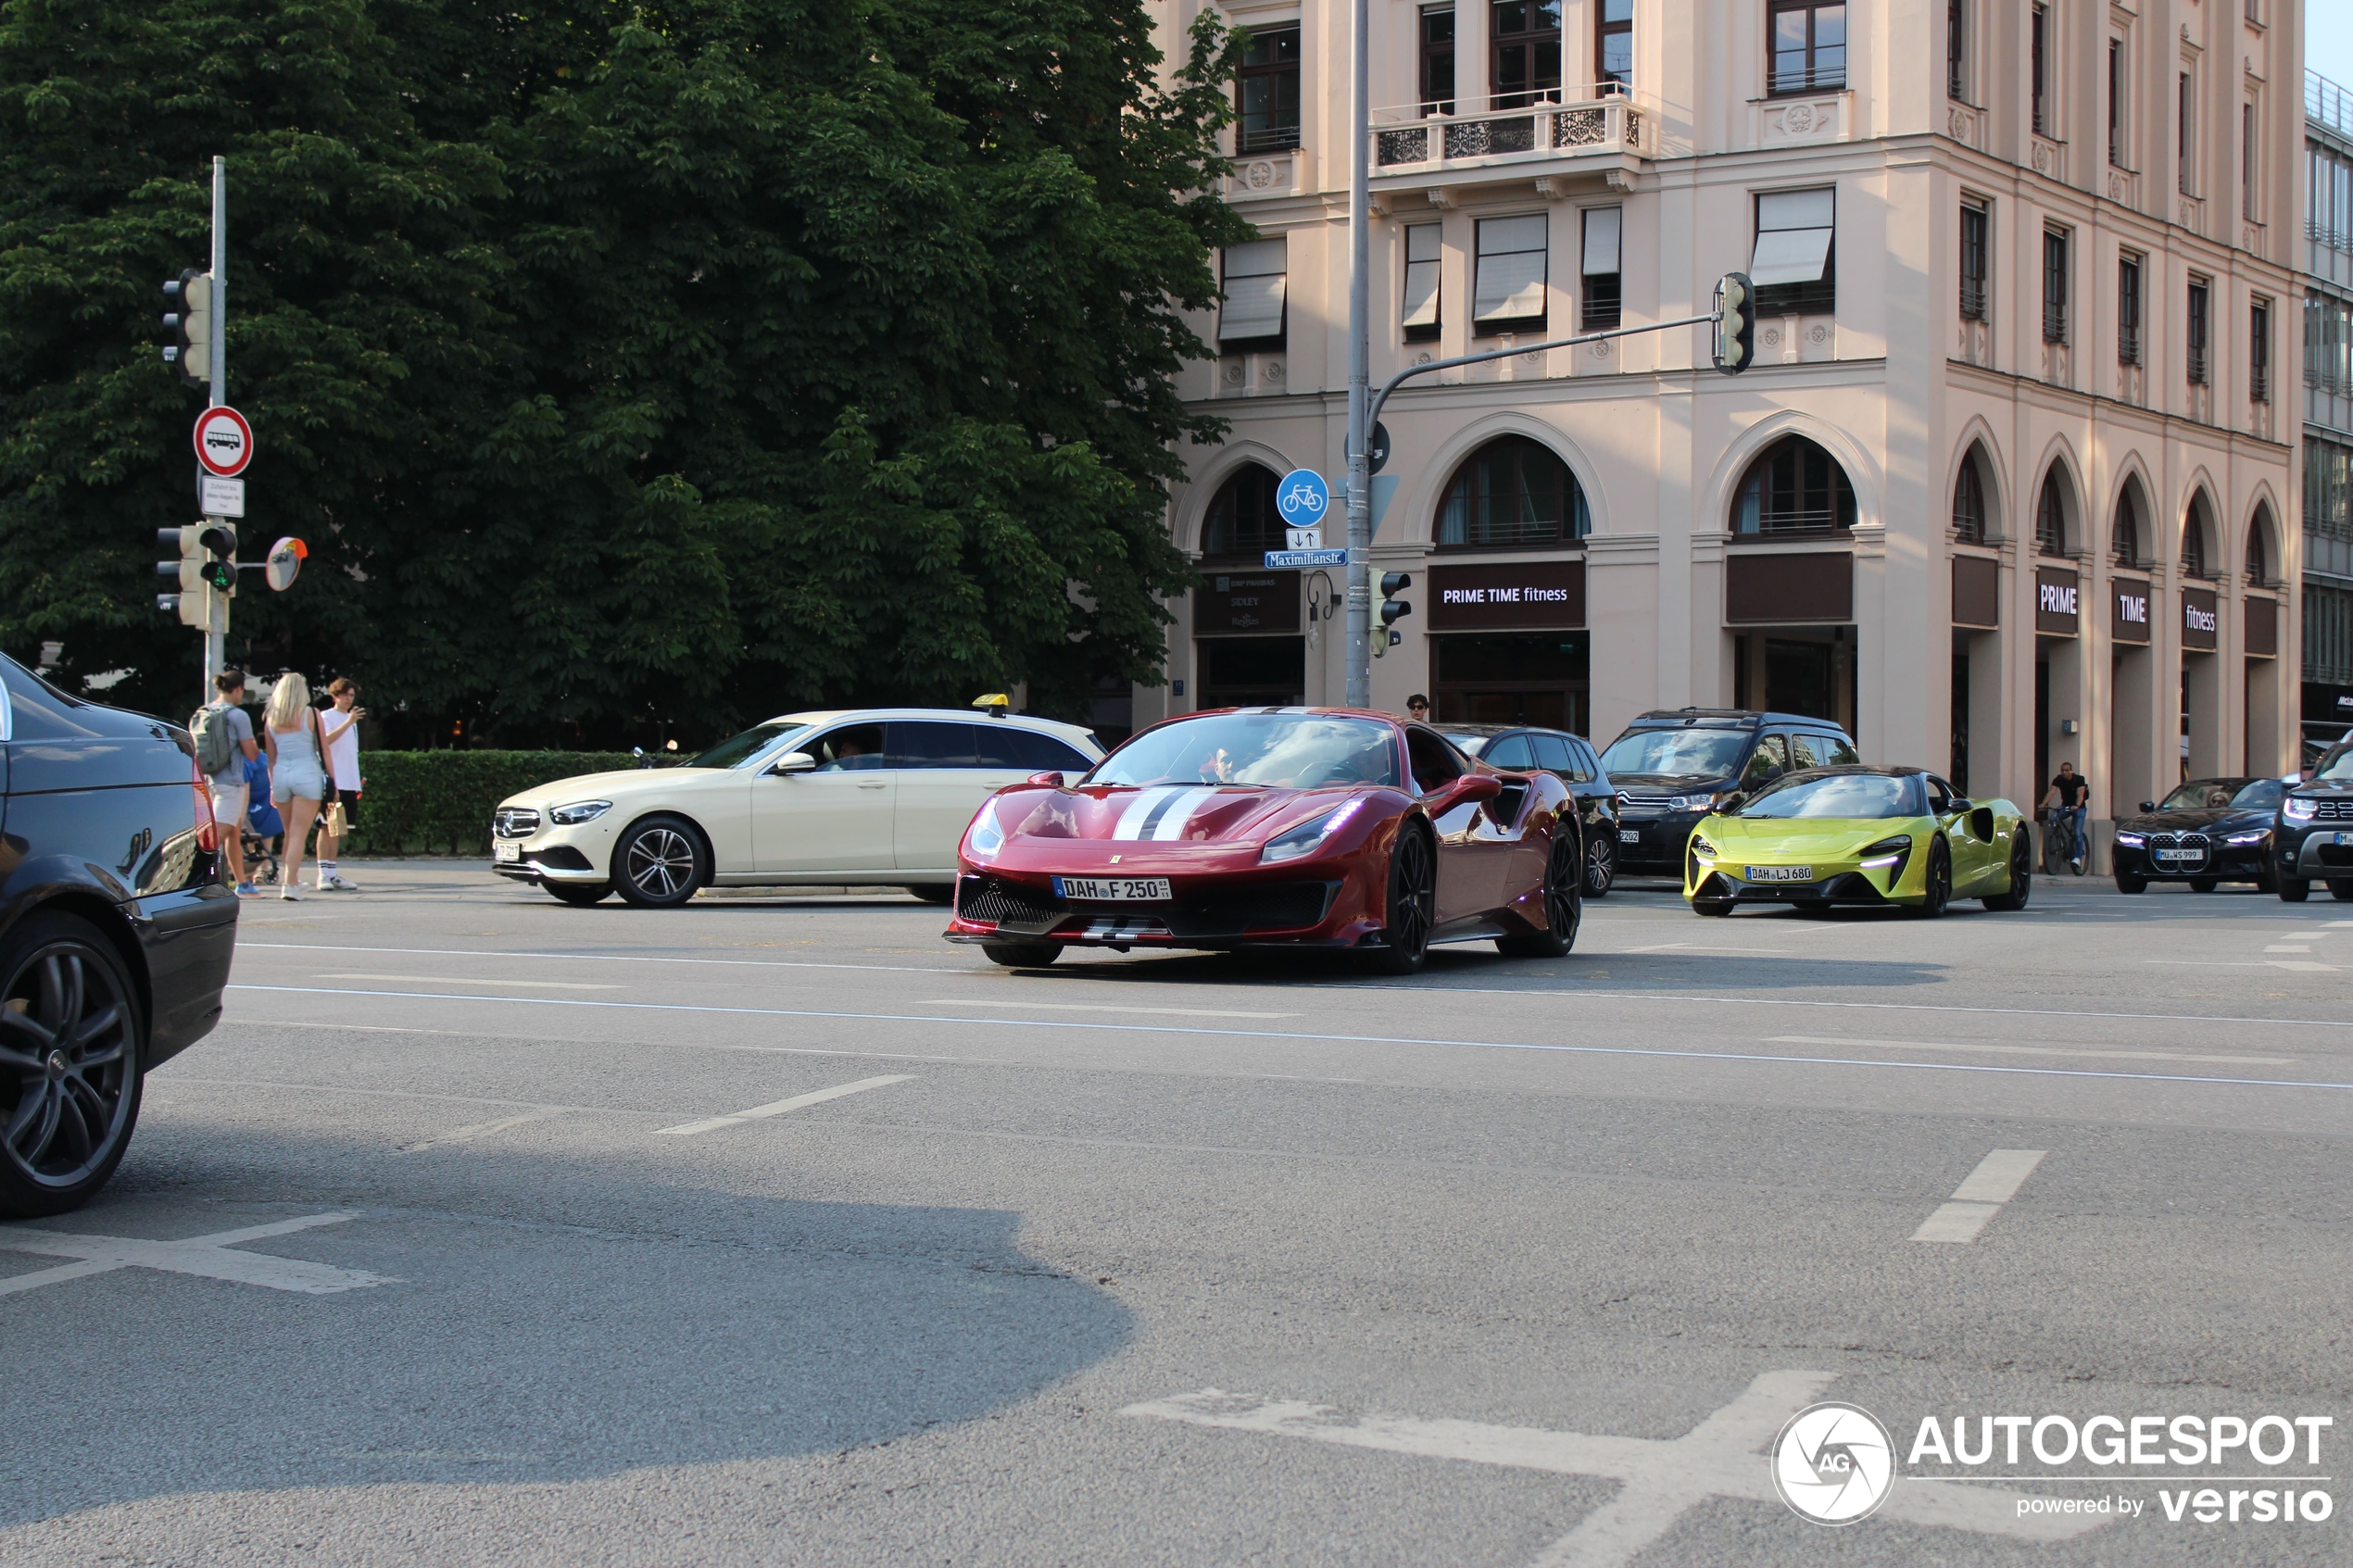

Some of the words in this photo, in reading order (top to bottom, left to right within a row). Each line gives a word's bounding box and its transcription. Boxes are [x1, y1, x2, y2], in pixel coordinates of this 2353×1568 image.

[1270, 553, 1341, 566] Maximilianstr.
[1231, 597, 1259, 607] SIDLEY
[1443, 589, 1485, 603] PRIME
[1488, 588, 1520, 602] TIME
[1524, 587, 1567, 601] fitness
[2040, 584, 2077, 615] PRIME
[2120, 595, 2145, 623] TIME
[1231, 617, 1260, 627] Regus
[2186, 605, 2215, 632] fitness
[1752, 868, 1769, 879] DAH
[1777, 869, 1790, 880] LJ
[1792, 868, 1811, 879] 680
[1063, 880, 1098, 897] DAH
[1109, 882, 1119, 897] F
[1124, 881, 1158, 897] 250
